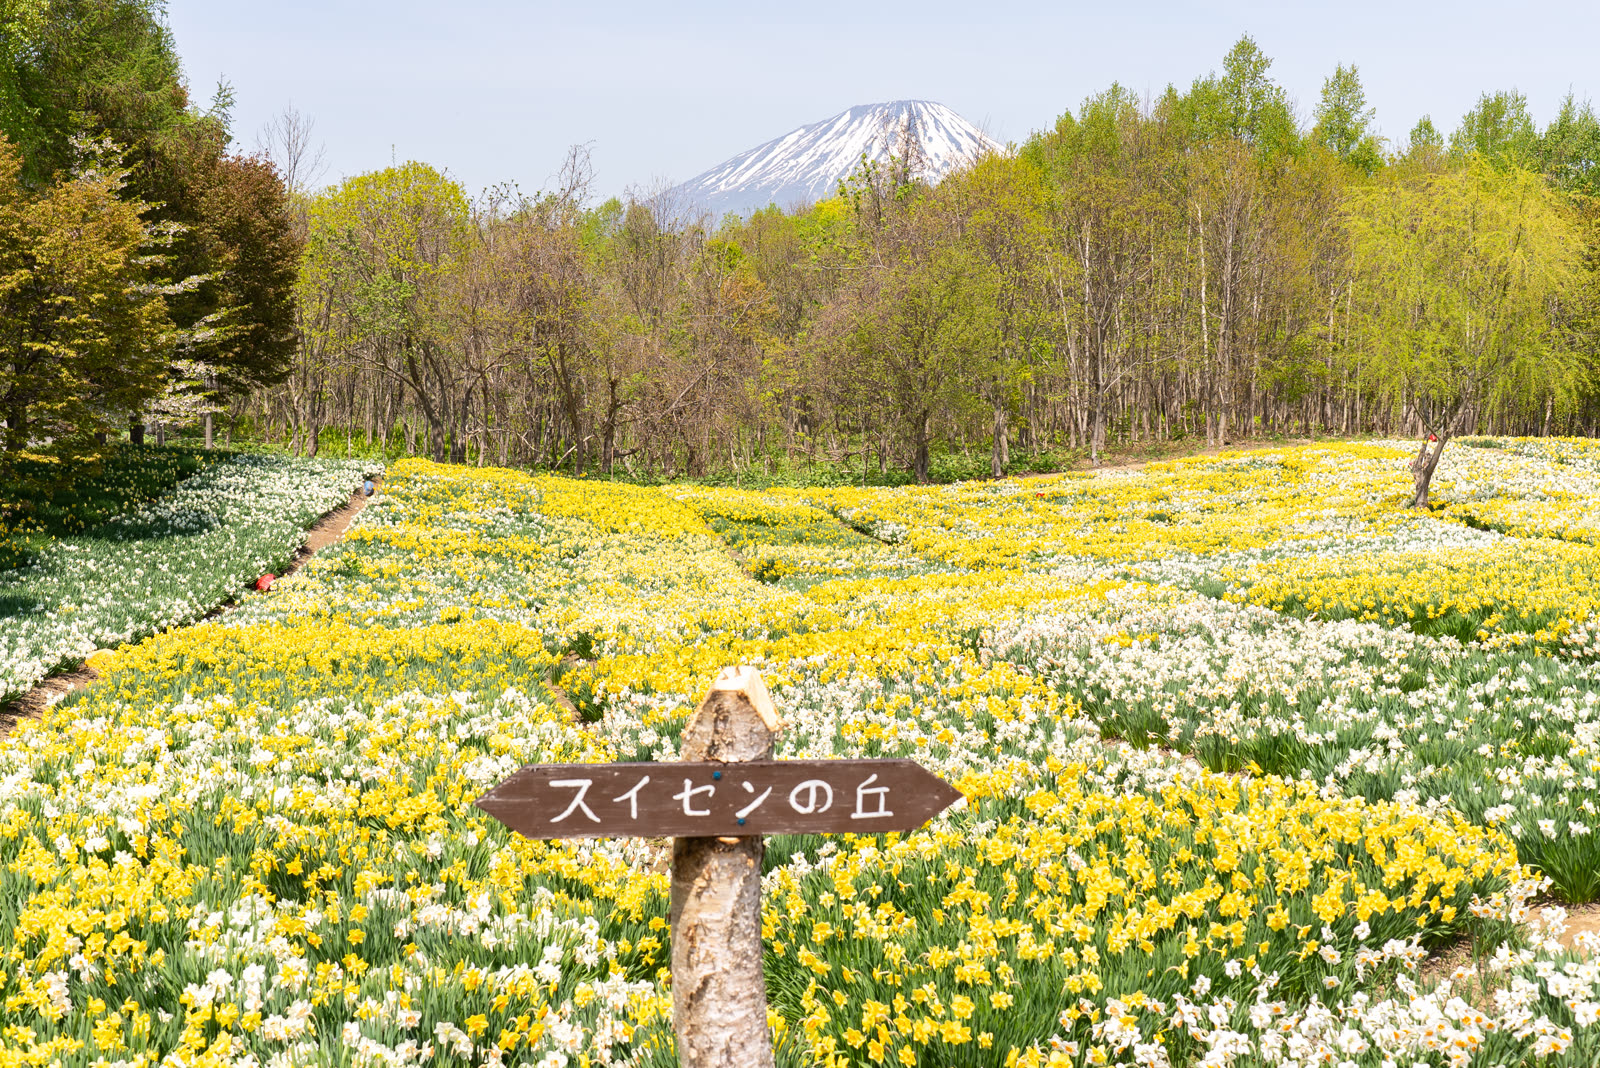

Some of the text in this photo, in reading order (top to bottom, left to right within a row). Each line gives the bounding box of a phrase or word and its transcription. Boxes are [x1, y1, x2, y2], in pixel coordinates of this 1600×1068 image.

[548, 773, 894, 823] スイセンの丘
